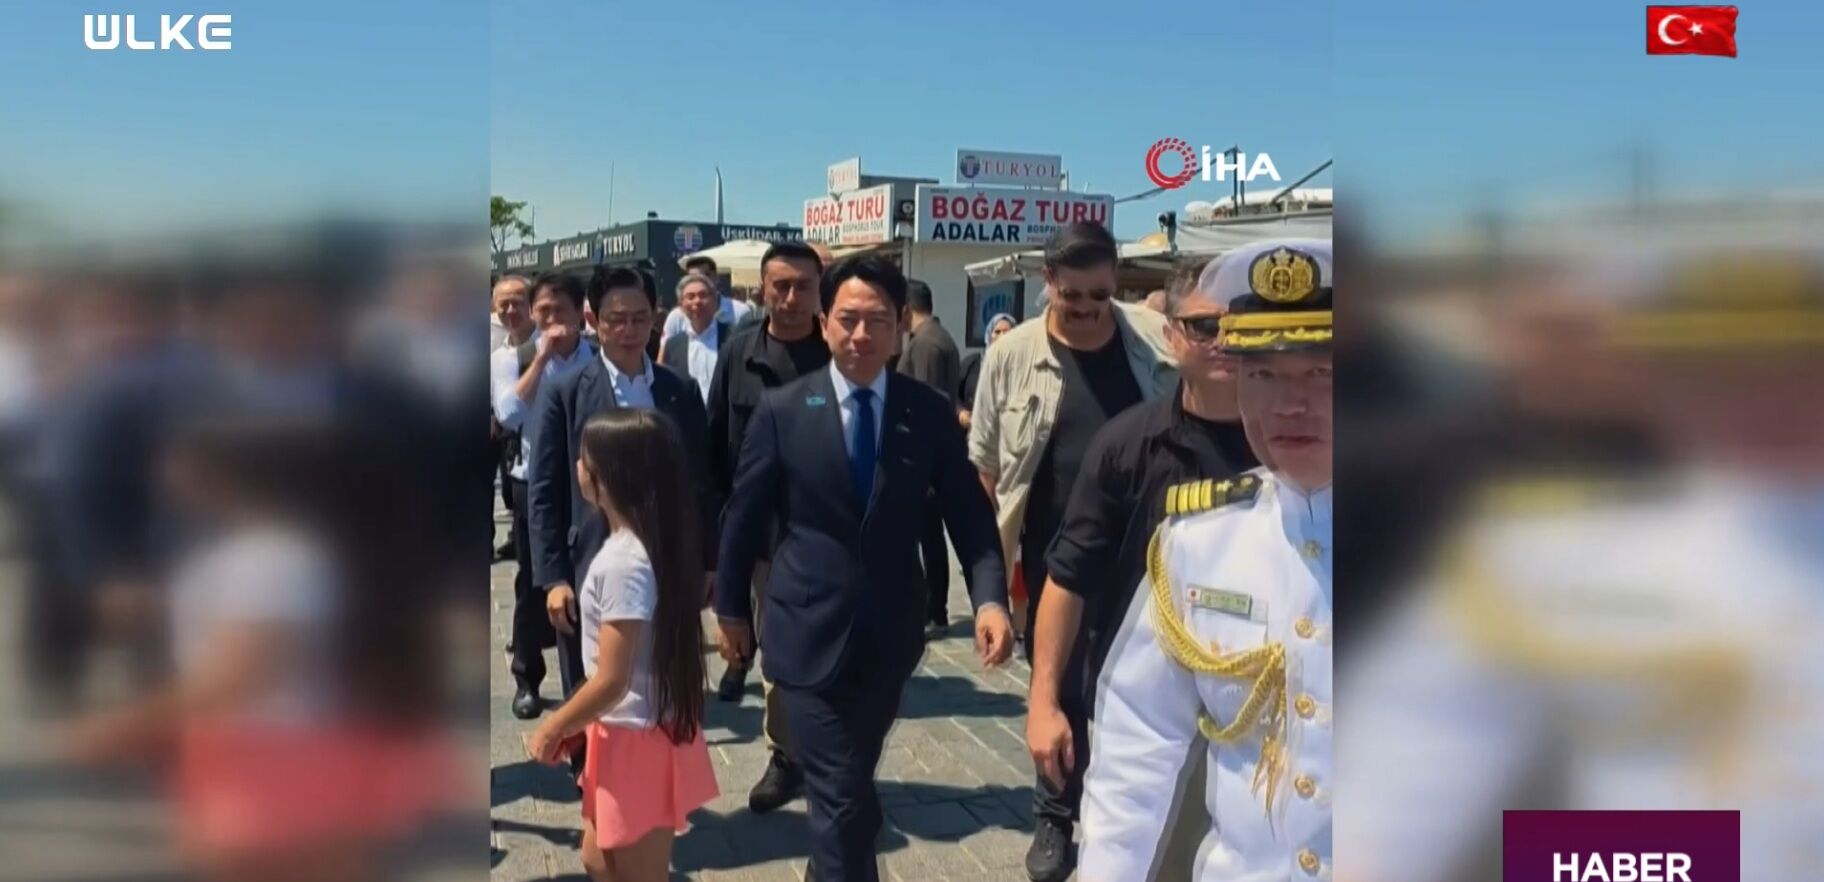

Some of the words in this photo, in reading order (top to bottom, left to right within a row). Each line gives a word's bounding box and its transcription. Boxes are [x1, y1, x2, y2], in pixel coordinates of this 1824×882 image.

[982, 160, 1058, 177] TURYOL
[806, 201, 843, 226] BOĞAZ
[847, 195, 884, 221] TURU
[932, 191, 1025, 221] BOĞAZ
[1036, 200, 1106, 225] TURU
[932, 221, 1020, 242] ADALAR
[603, 233, 634, 255] TURYOL
